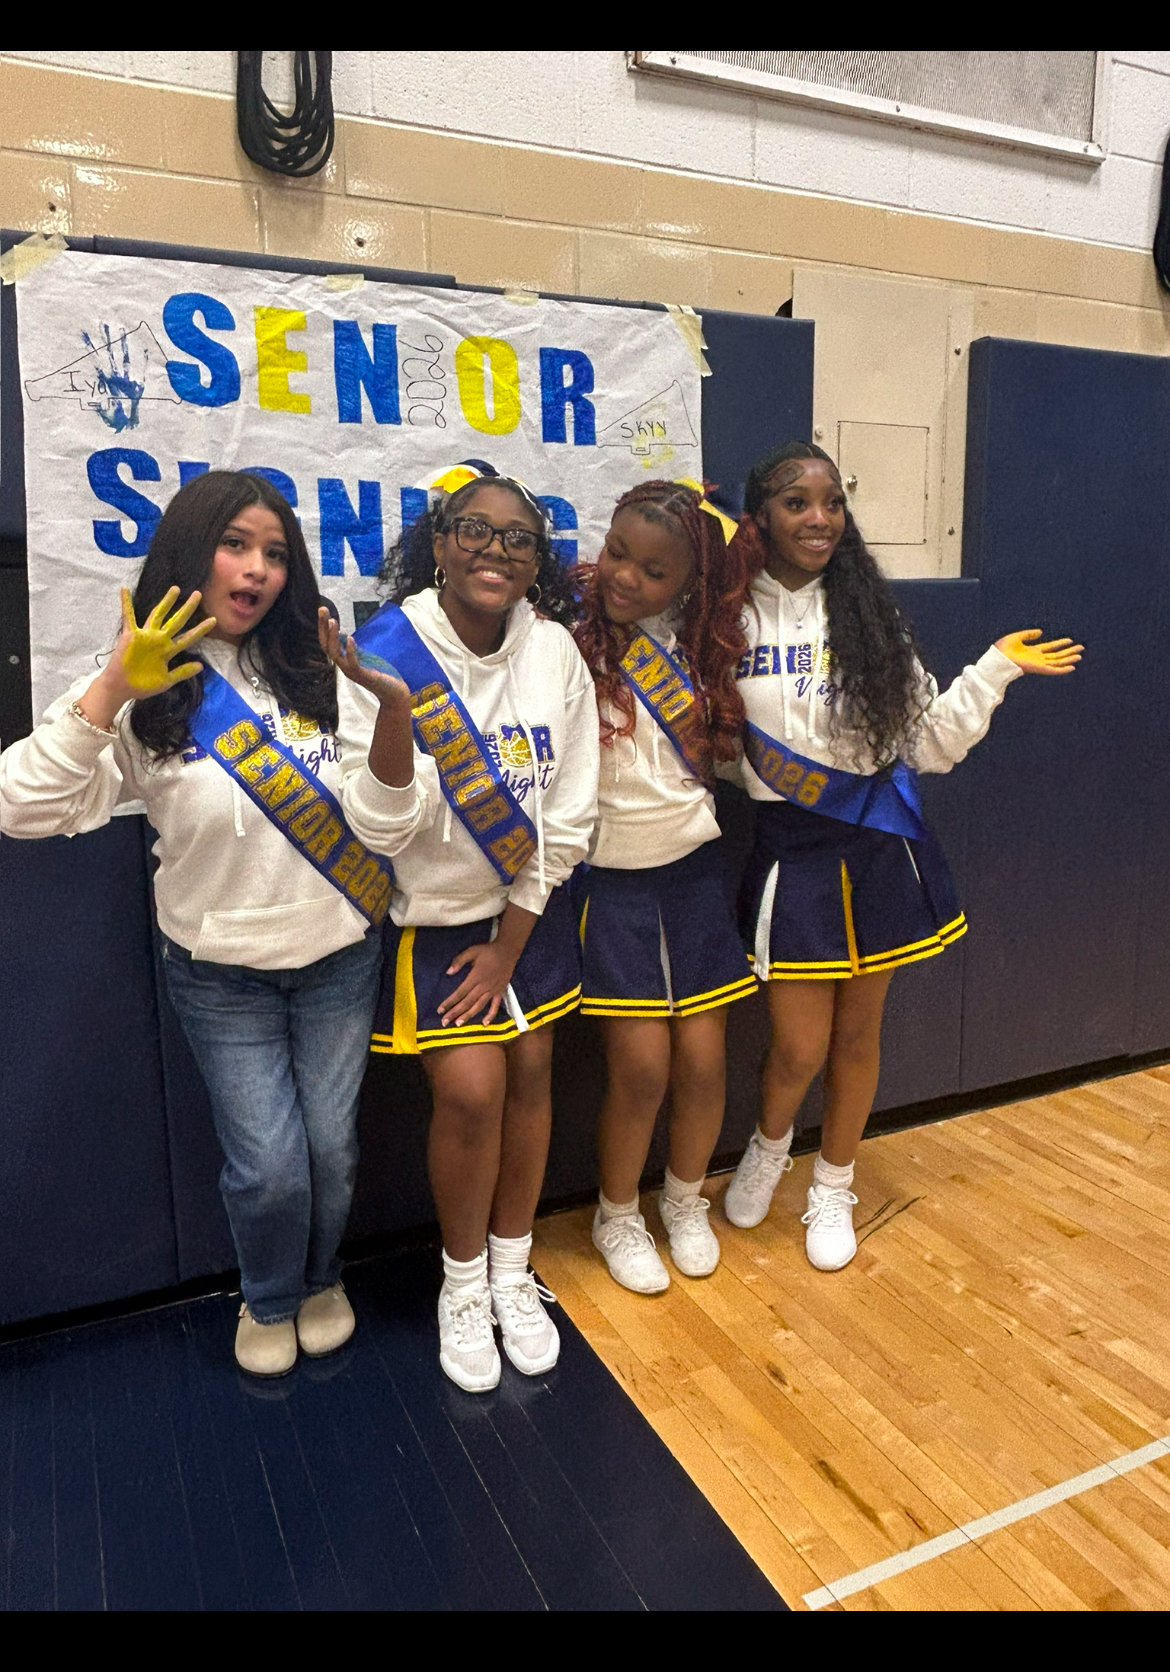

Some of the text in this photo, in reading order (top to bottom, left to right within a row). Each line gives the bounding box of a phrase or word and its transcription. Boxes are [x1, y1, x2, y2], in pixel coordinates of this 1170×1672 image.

[398, 334, 447, 429] 2026
[617, 634, 698, 736] ENIO
[797, 642, 812, 674] 2026
[213, 719, 345, 864] SENIOR
[299, 737, 342, 778] ight
[410, 681, 513, 835] SENIOR
[759, 746, 829, 807] 026
